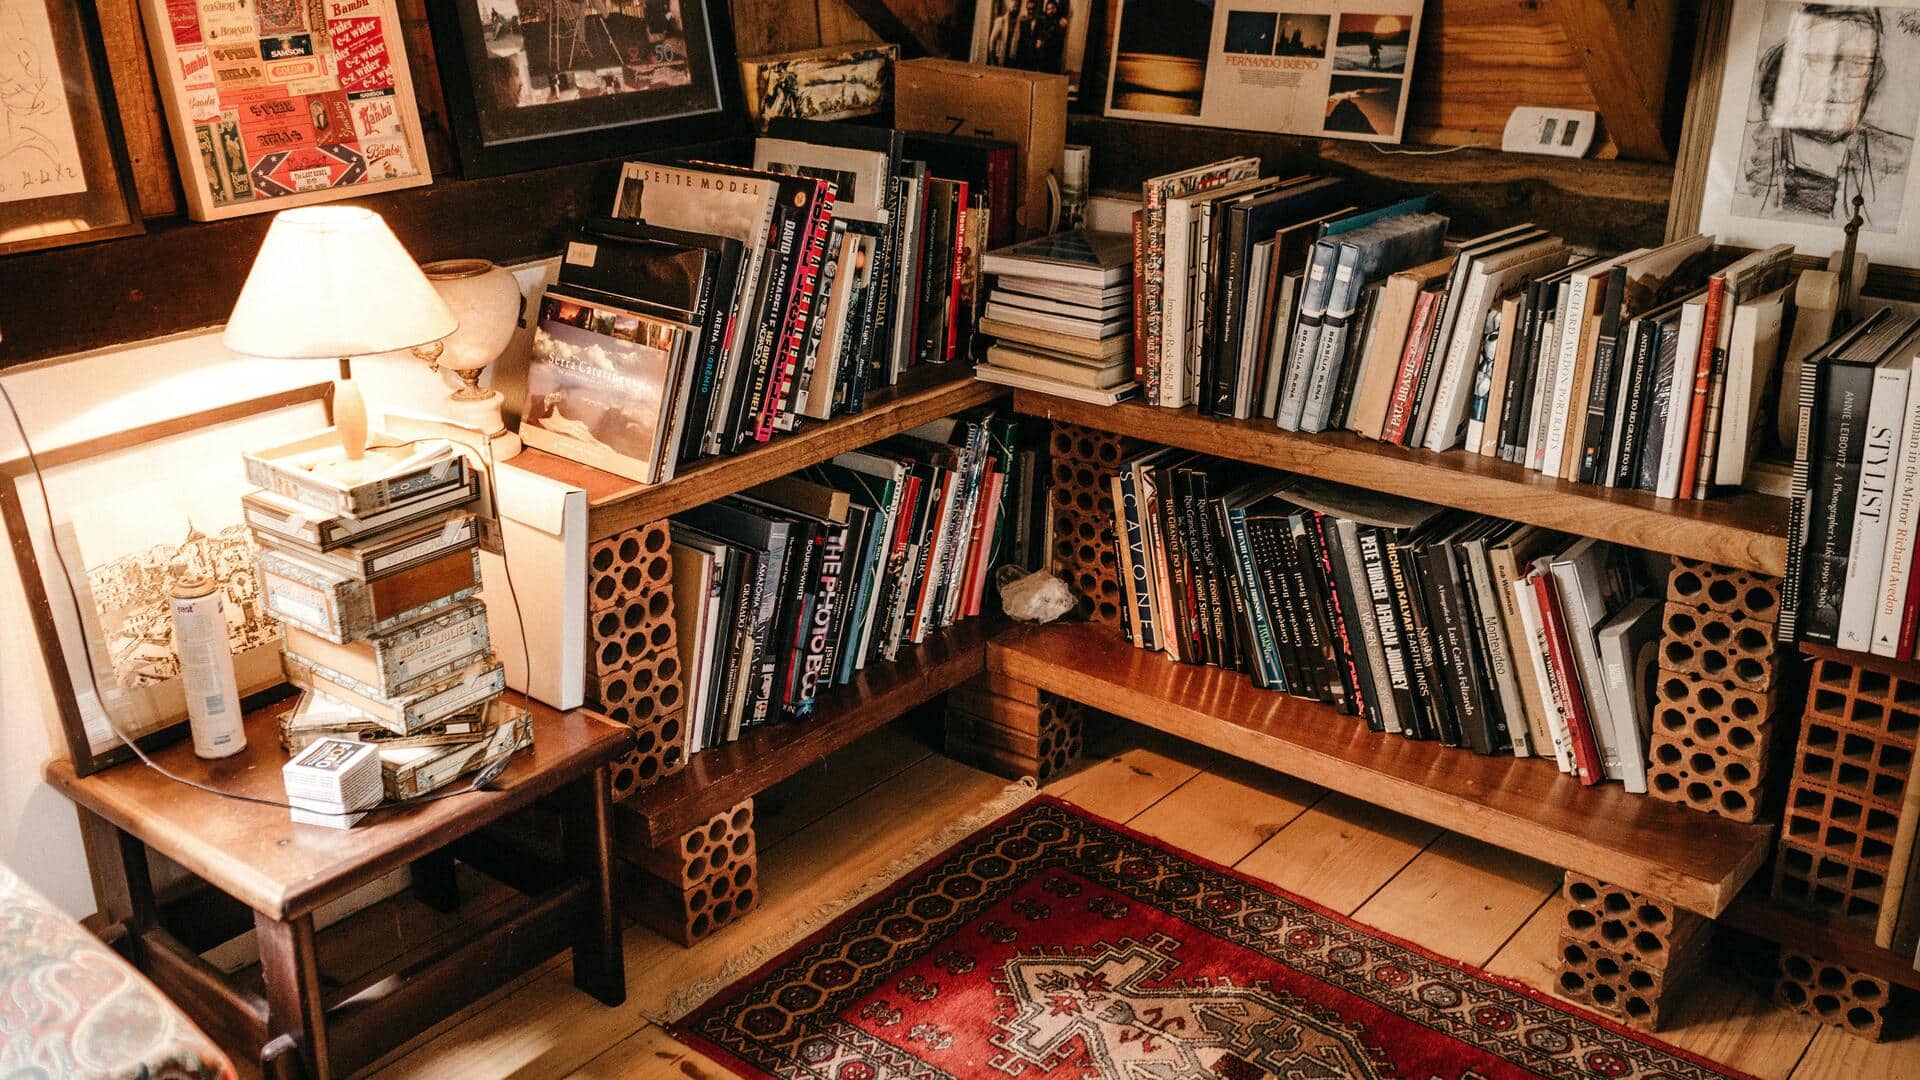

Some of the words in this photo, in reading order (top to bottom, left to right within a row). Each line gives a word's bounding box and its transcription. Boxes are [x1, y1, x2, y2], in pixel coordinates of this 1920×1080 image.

[350, 20, 376, 38] wider
[270, 47, 304, 58] SAMSON
[361, 43, 385, 60] wider
[1225, 55, 1281, 69] FERNANDO
[1283, 59, 1320, 71] BUENO
[355, 60, 380, 78] wider
[626, 167, 693, 187] LISETTE
[700, 178, 758, 195] MODEL
[1148, 188, 1157, 208] LIFE
[757, 195, 774, 249] LISETTE
[956, 210, 967, 234] flesh
[777, 220, 796, 255] DAVID
[1134, 221, 1142, 255] HAVANA
[747, 253, 762, 300] MODEL
[952, 254, 963, 280] spirit
[1134, 257, 1142, 277] VIEJA
[1165, 298, 1175, 326] Images
[1566, 280, 1584, 335] RICHARD
[709, 309, 724, 343] ARENA
[548, 351, 577, 370] Serra
[708, 344, 716, 355] DO
[756, 330, 774, 374] HEAVEN
[1164, 339, 1174, 358] Rock
[1294, 329, 1308, 370] BRASÍLIA
[1320, 330, 1334, 371] BRASÍLIA
[1559, 338, 1575, 384] AVEDON
[1637, 333, 1647, 363] ANTIGAS
[1164, 373, 1174, 390] Roll
[1288, 372, 1298, 399] PLENA
[1313, 374, 1324, 401] PLENA
[1390, 355, 1416, 427] PAU-BRASIL
[1632, 364, 1643, 398] FAZENDAS
[746, 392, 761, 420] HELL
[1628, 411, 1636, 423] RIO
[1631, 399, 1638, 410] DO
[1841, 390, 1855, 420] ANNIE
[1549, 387, 1567, 452] PORTRAITS
[1624, 423, 1634, 452] GRANDE
[1835, 421, 1850, 469] LEIBOVITZ
[1622, 453, 1630, 465] DO
[1907, 450, 1919, 463] in
[1834, 473, 1844, 482] A
[1859, 425, 1893, 524] STYLIST
[1904, 462, 1918, 484] the
[1164, 498, 1174, 514] RIO
[1183, 494, 1193, 509] Rio
[1196, 498, 1207, 513] Rio
[1823, 481, 1842, 540] Photographer's
[1897, 485, 1914, 525] Mirror
[1167, 515, 1179, 551] GRANDE
[1185, 508, 1197, 536] Grande
[1198, 512, 1210, 540] Grande
[916, 527, 934, 580] CAMERA
[1117, 470, 1154, 631] SCAVONE
[1189, 536, 1199, 548] do
[1190, 548, 1201, 562] Sul
[1203, 540, 1212, 552] do
[1359, 534, 1380, 561] PETE
[1889, 527, 1909, 574] Richard
[795, 538, 814, 600] BOURKE-WHITE
[1172, 553, 1180, 567] DO
[1203, 551, 1214, 566] Sul
[1496, 563, 1508, 578] Bob
[752, 562, 767, 608] AMAZÔNIA
[1173, 567, 1183, 584] SUL
[1194, 573, 1206, 601] Leonid
[1262, 568, 1277, 595] Brasil
[1277, 571, 1291, 599] Brasil
[1292, 571, 1307, 598] Brasil
[1365, 559, 1390, 601] TURNER
[737, 582, 750, 628] GRAMADO
[1208, 578, 1220, 605] Leonid
[1270, 594, 1280, 608] do
[1283, 599, 1294, 612] do
[1300, 598, 1311, 612] do
[1498, 577, 1518, 616] Wolfenson
[1883, 574, 1900, 616] Avedon
[1272, 607, 1290, 644] Coração
[1286, 611, 1303, 648] Coração
[1303, 610, 1321, 647] Coração
[1360, 610, 1378, 648] WOMEN
[1373, 600, 1399, 647] AFRICAN
[1385, 541, 1404, 590] RICHARD
[1396, 589, 1414, 632] KALVAR
[1405, 631, 1429, 697] EARTHLINGS
[1446, 626, 1459, 645] Luiz
[1484, 613, 1506, 676] Montevideo
[820, 645, 834, 677] Brasil
[1383, 644, 1409, 693] JOURNEY
[1450, 645, 1466, 675] Carlos
[1456, 674, 1475, 717] Felizardo
